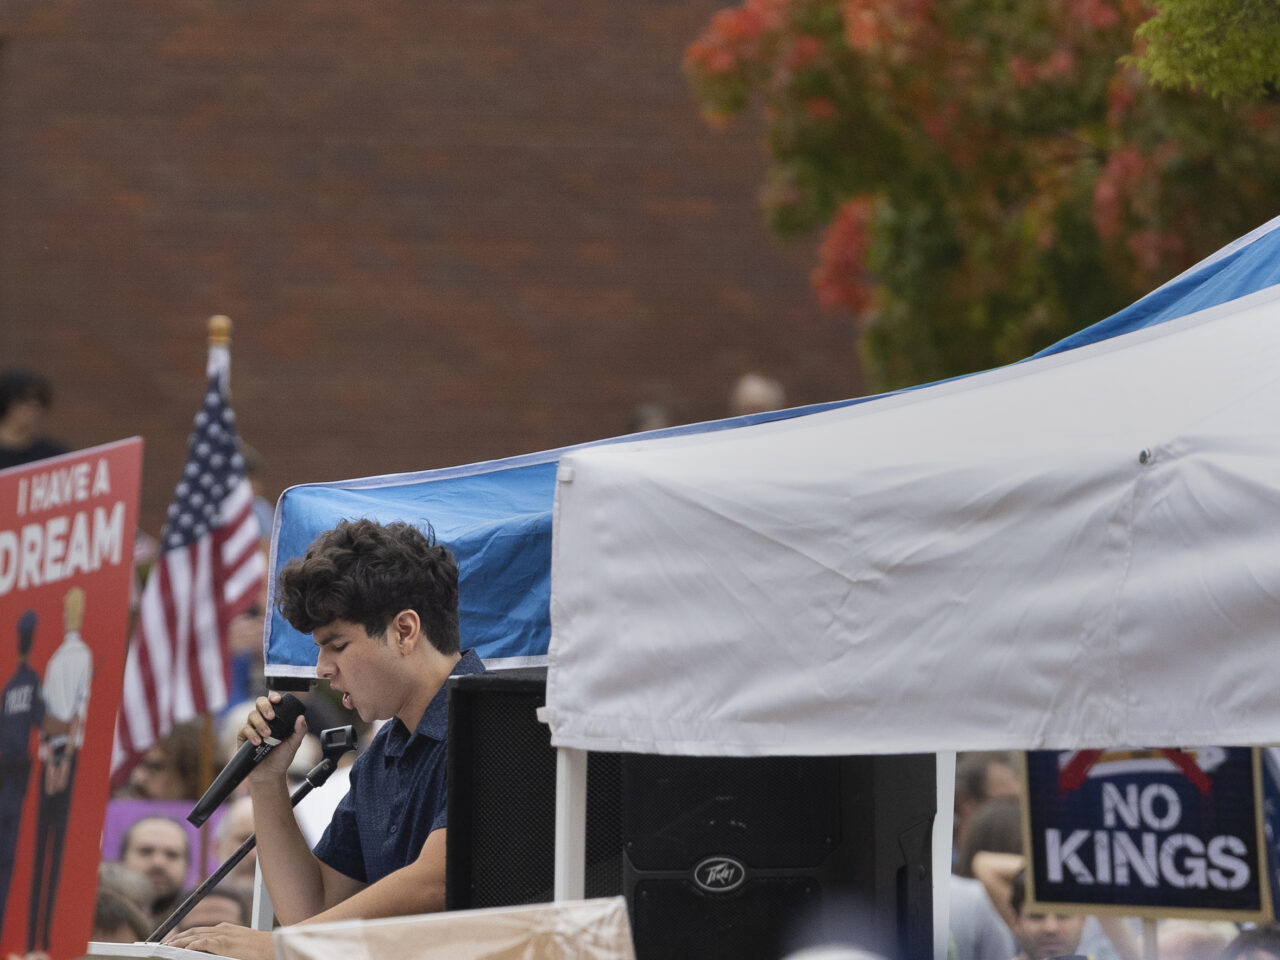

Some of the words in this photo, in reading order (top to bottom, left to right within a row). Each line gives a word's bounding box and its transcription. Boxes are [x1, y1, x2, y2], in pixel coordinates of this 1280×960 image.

[17, 477, 29, 516] I
[30, 463, 91, 512] HAVE
[92, 458, 111, 496] A
[1102, 782, 1182, 831] NO
[1045, 828, 1251, 891] KINGS
